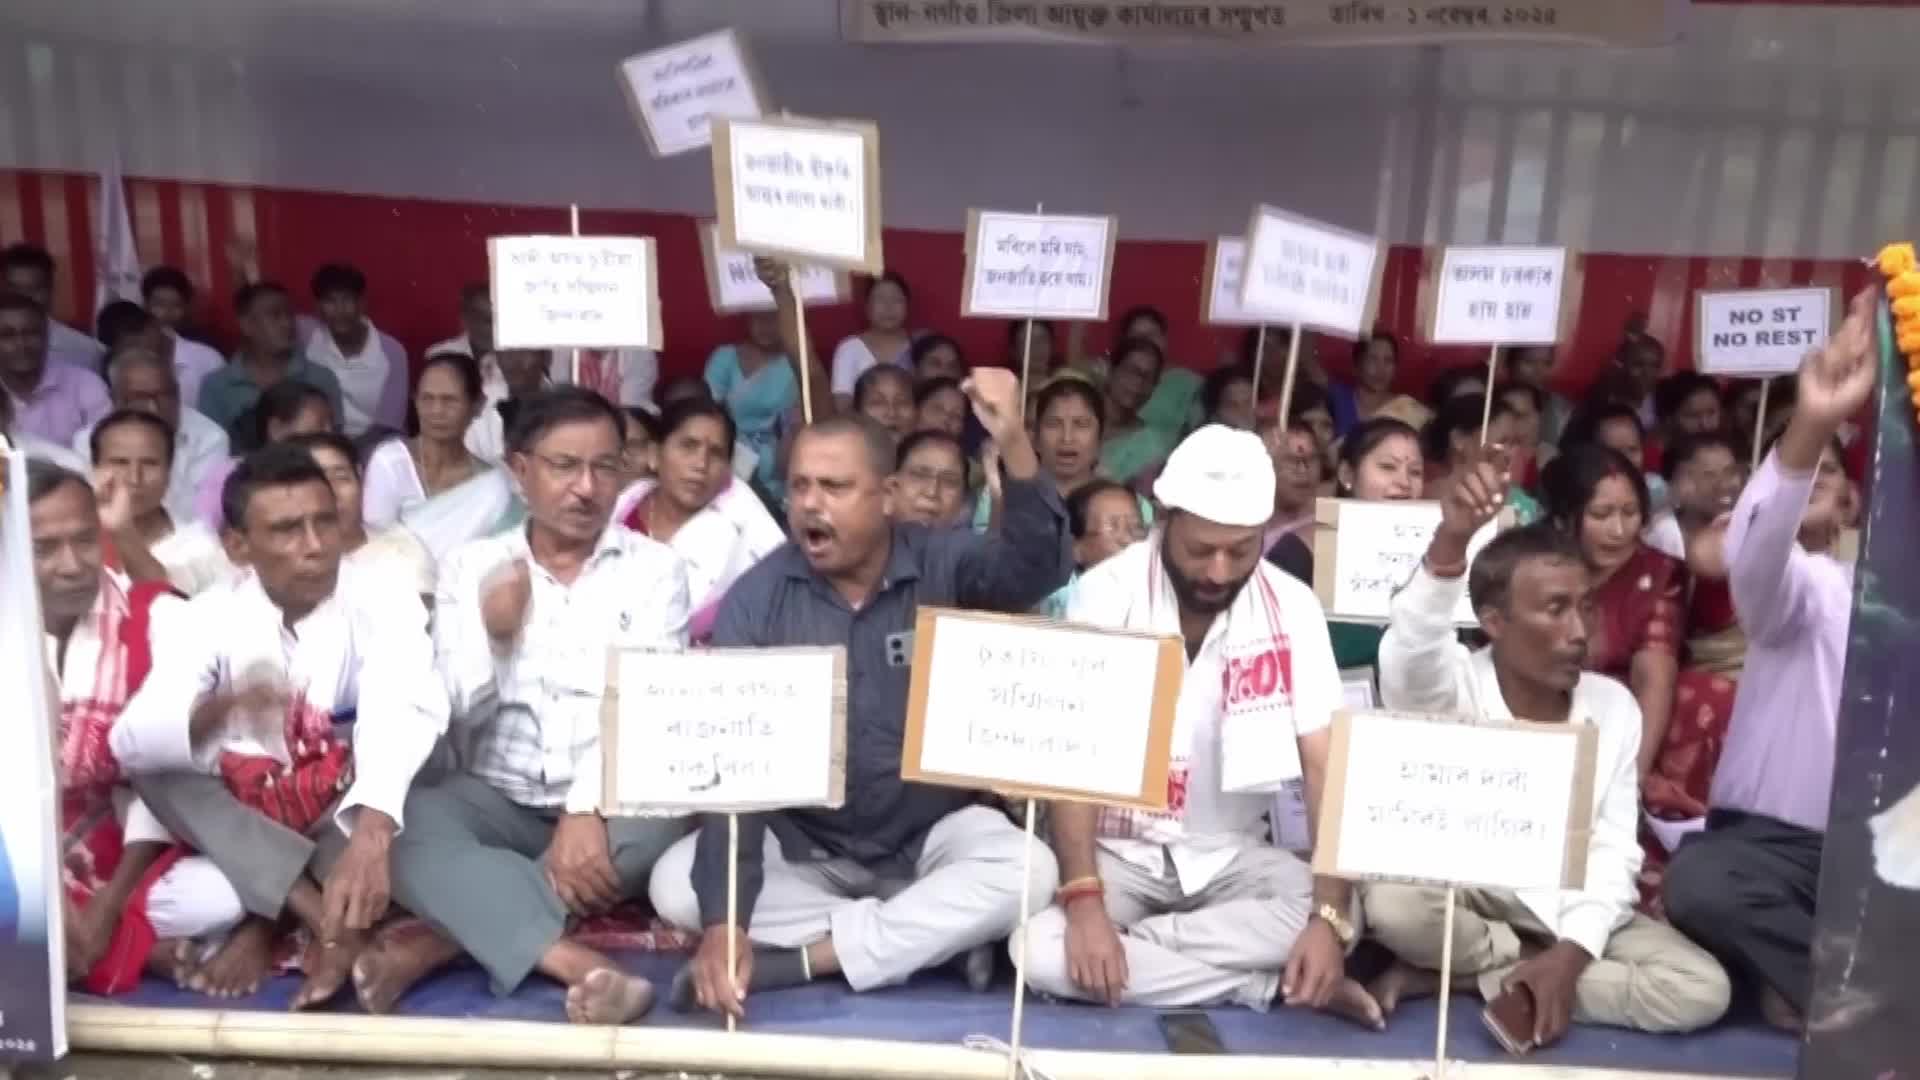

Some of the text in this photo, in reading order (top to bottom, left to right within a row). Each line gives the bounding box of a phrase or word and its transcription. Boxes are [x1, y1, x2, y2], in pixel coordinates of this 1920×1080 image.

[1729, 306, 1801, 325] NO ST
[1713, 328, 1816, 348] NO REST
